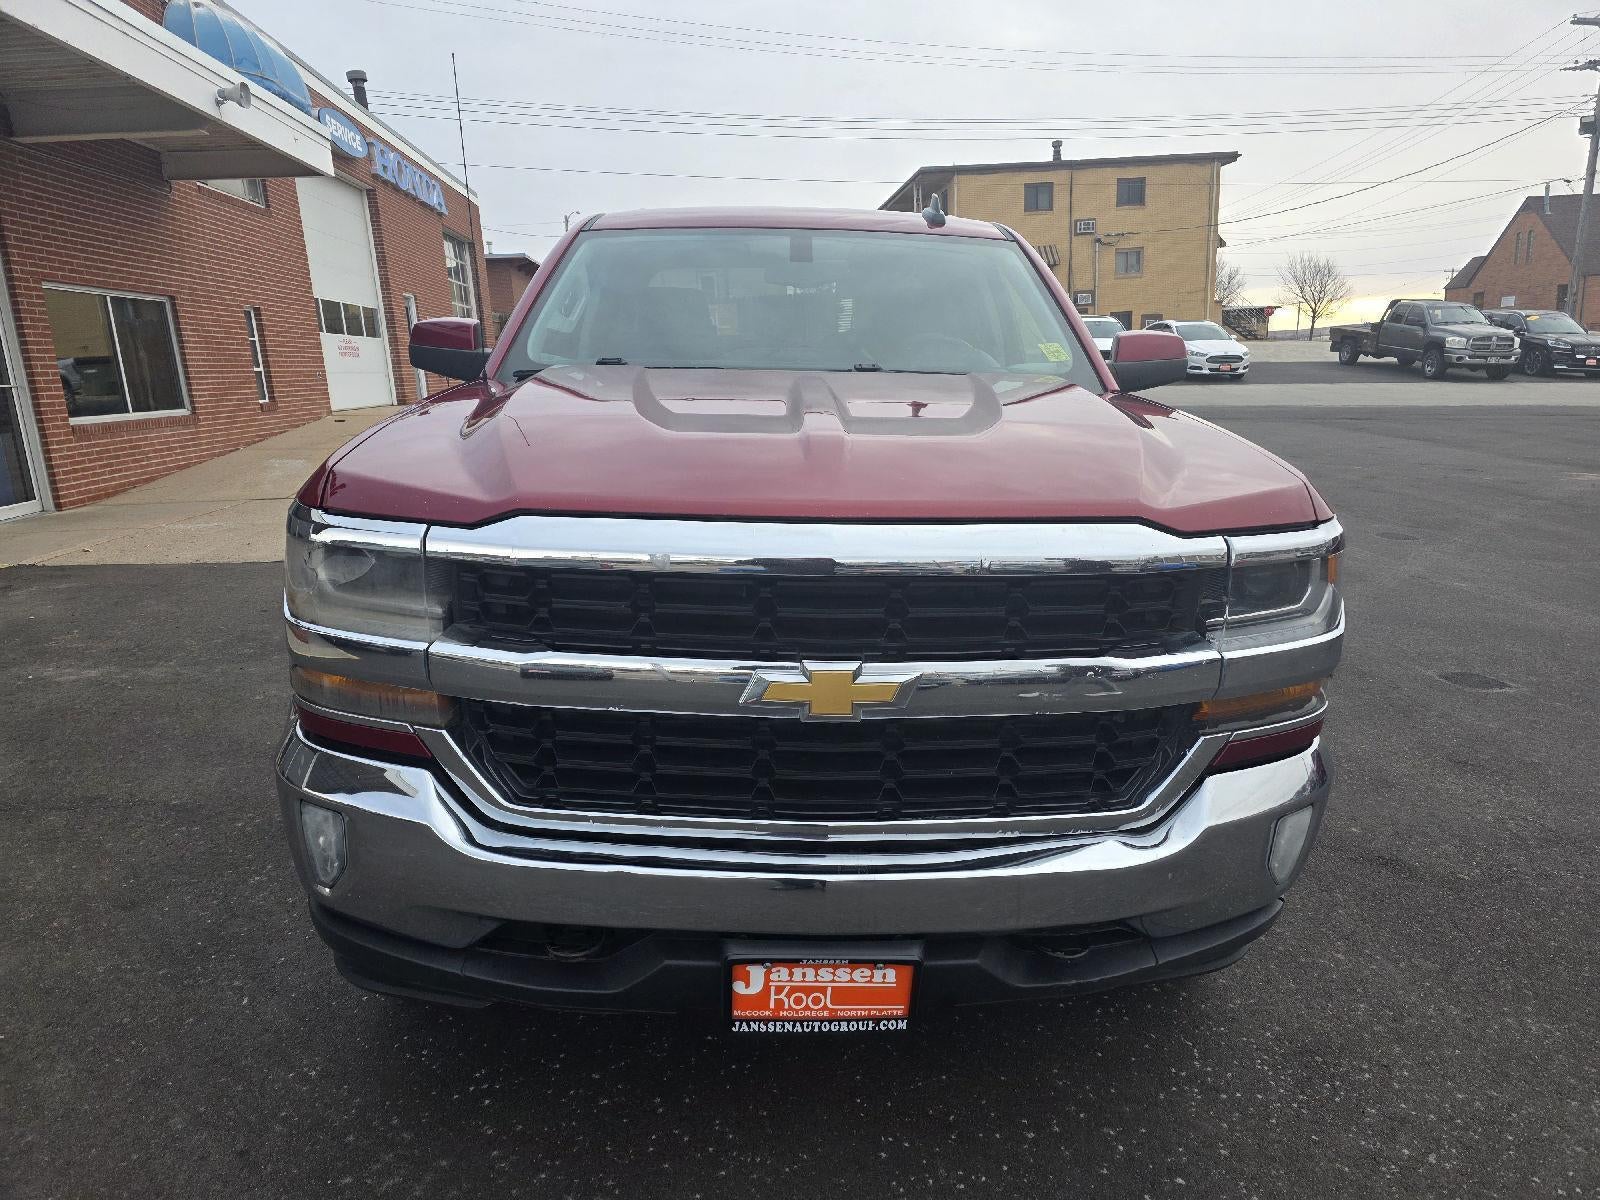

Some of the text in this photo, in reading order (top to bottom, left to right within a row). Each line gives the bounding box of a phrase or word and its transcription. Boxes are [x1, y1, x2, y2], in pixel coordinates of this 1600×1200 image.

[325, 114, 363, 152] SERVICE
[372, 139, 448, 215] HONDA
[732, 965, 896, 994] Janssen
[769, 986, 837, 1009] Kool
